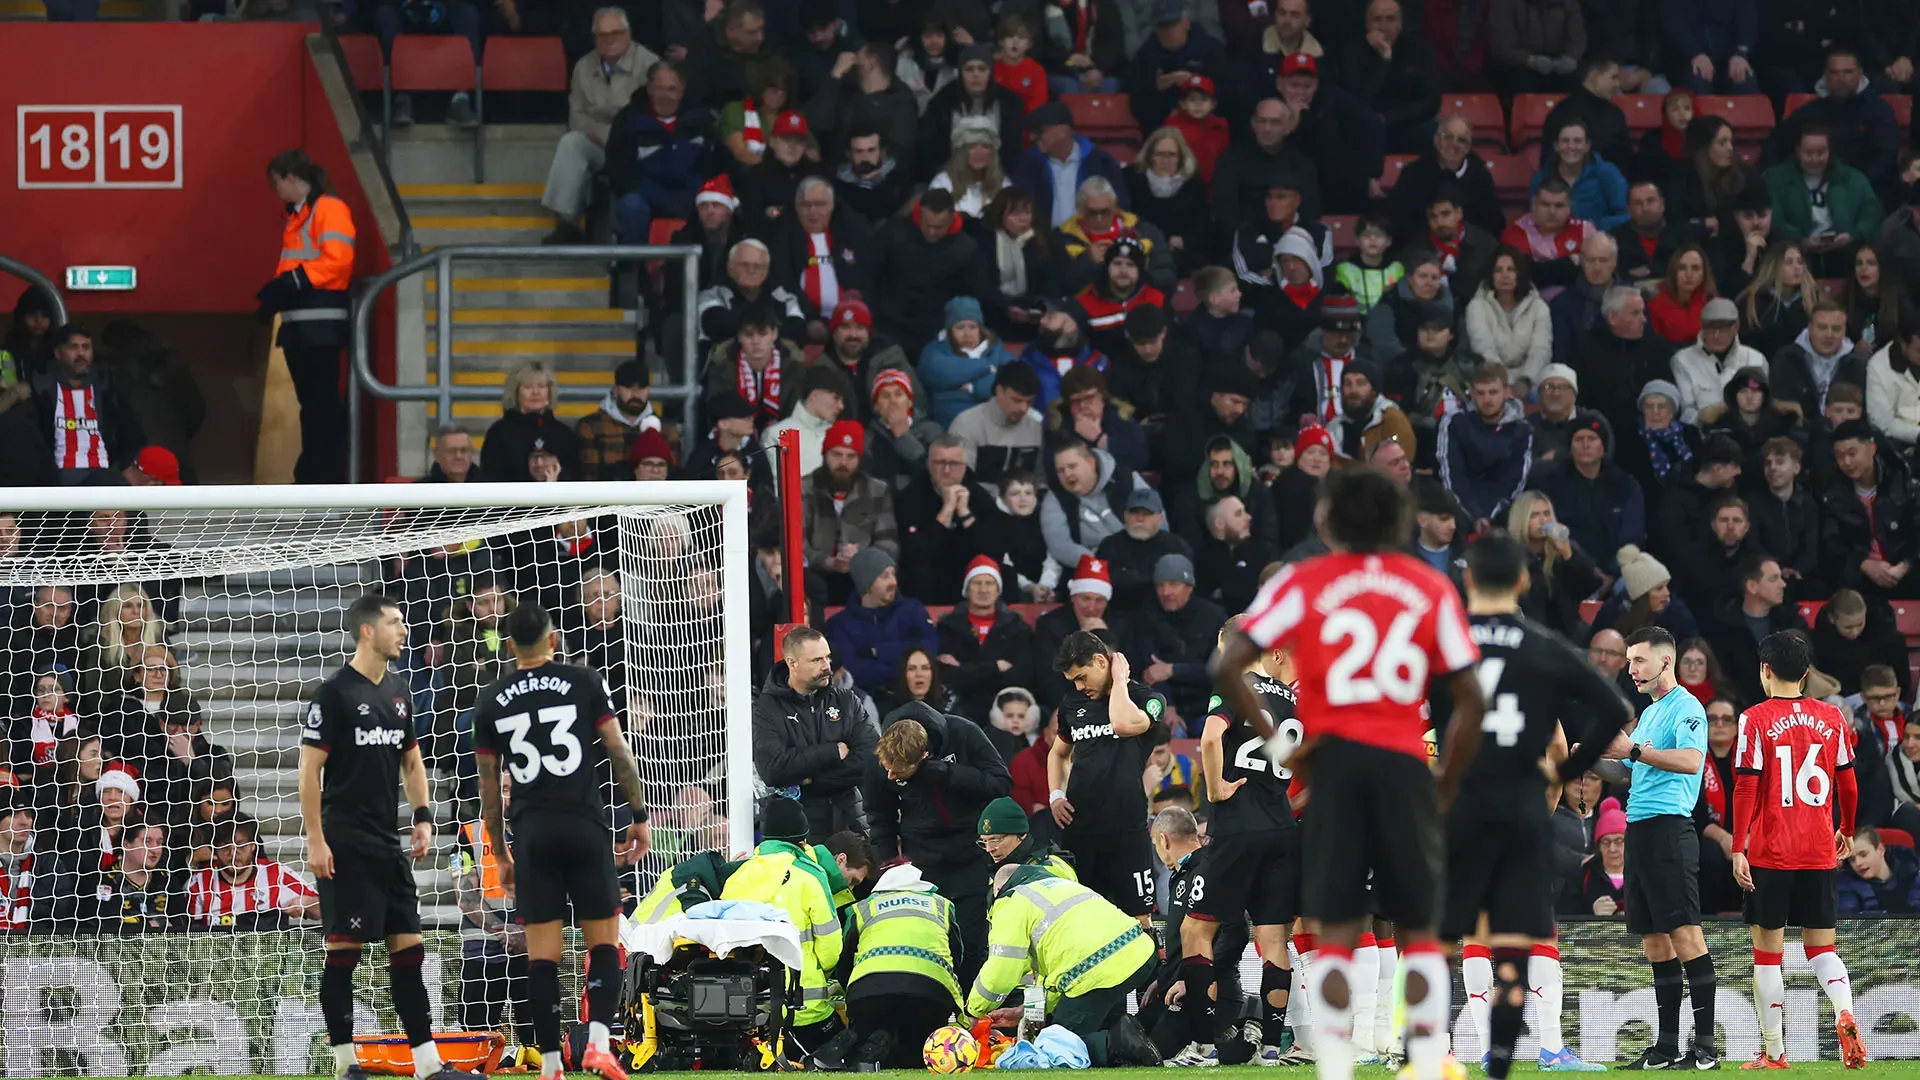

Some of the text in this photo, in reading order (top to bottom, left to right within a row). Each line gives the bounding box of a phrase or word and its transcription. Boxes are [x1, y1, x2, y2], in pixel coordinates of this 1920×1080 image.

[29, 123, 170, 170] 18 19
[1319, 608, 1430, 707] 26
[495, 675, 572, 708] EMERSON
[1477, 656, 1526, 748] 4
[494, 703, 583, 784] 33
[1766, 712, 1834, 741] SUGAWARA
[1775, 743, 1831, 808] 16
[1132, 868, 1155, 897] 15
[1190, 874, 1205, 901] 8
[877, 896, 929, 911] NURSE
